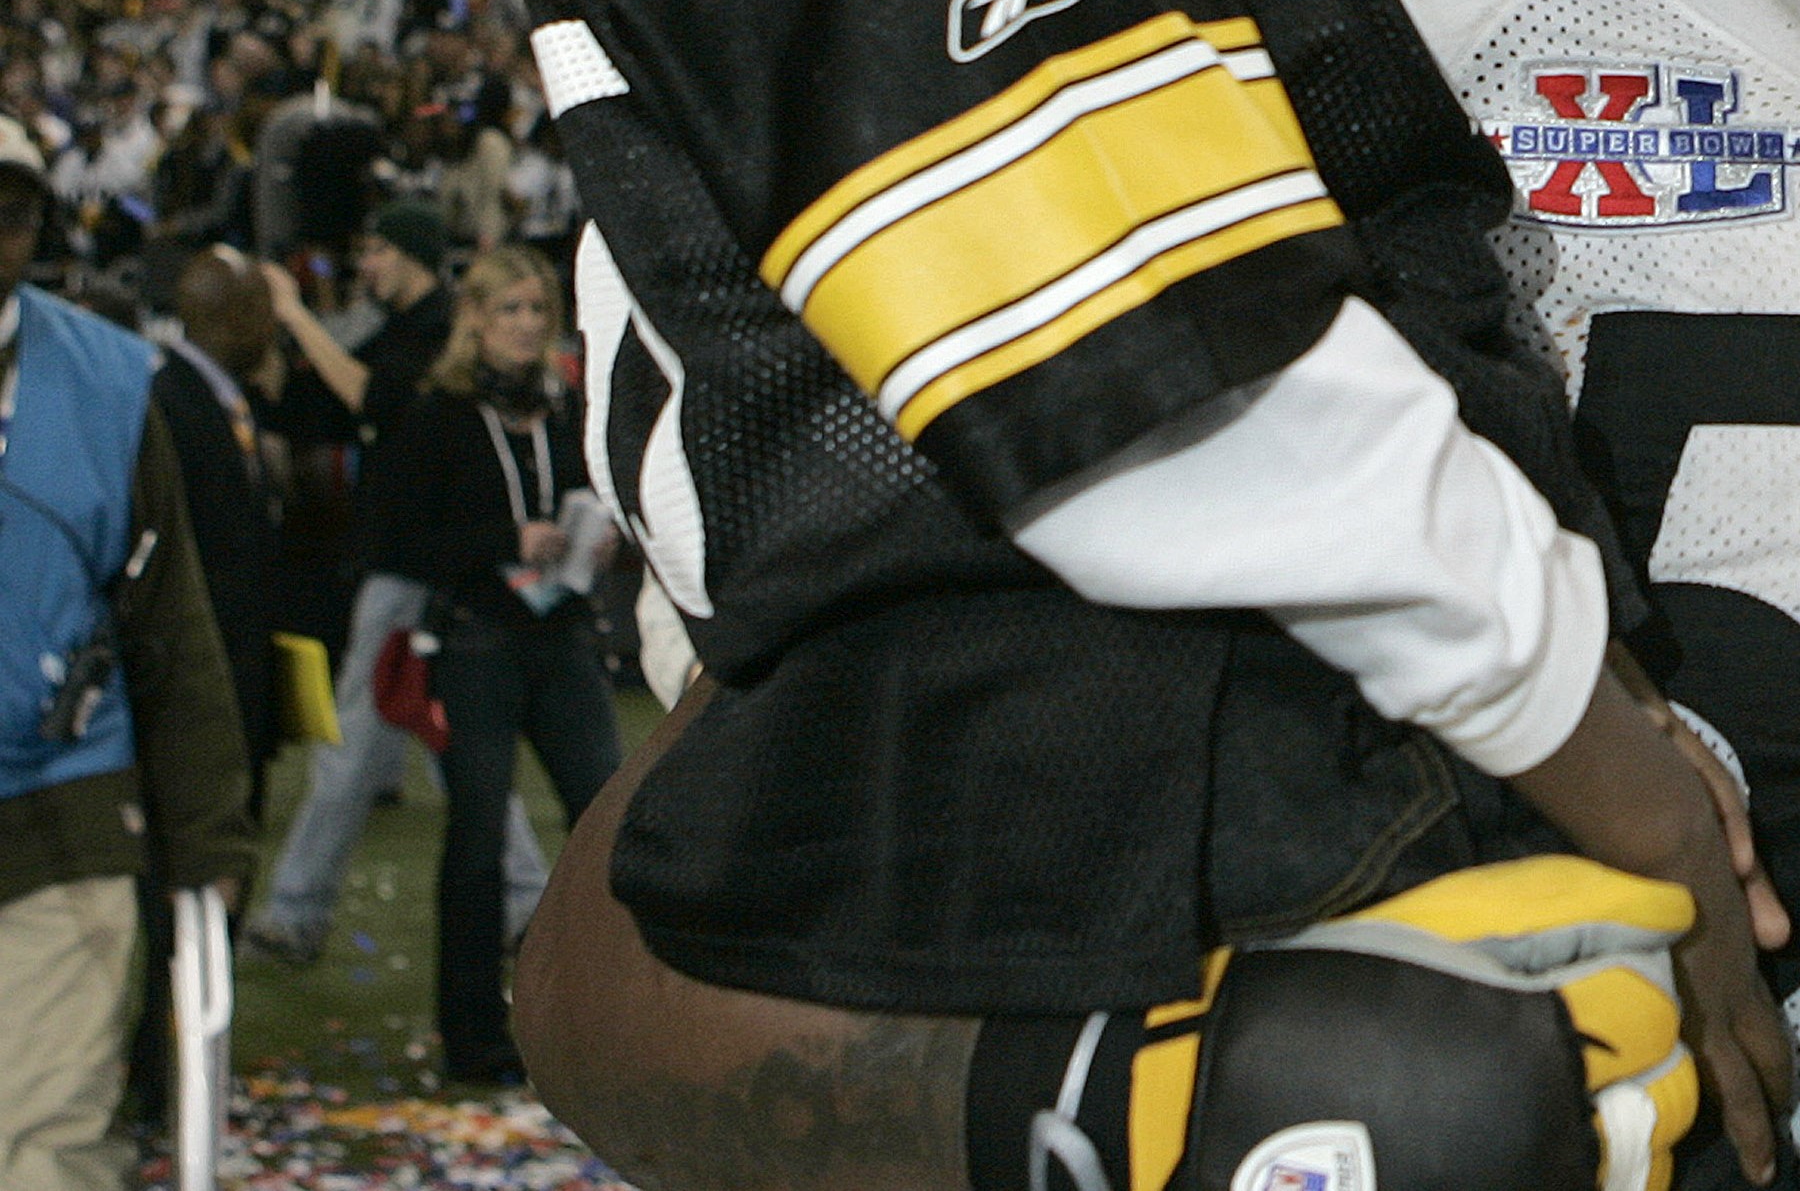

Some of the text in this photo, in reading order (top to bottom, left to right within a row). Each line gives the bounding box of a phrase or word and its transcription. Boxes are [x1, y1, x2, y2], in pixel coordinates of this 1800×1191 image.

[1514, 127, 1783, 157] SUPER BOWL
[1528, 72, 1776, 218] XL
